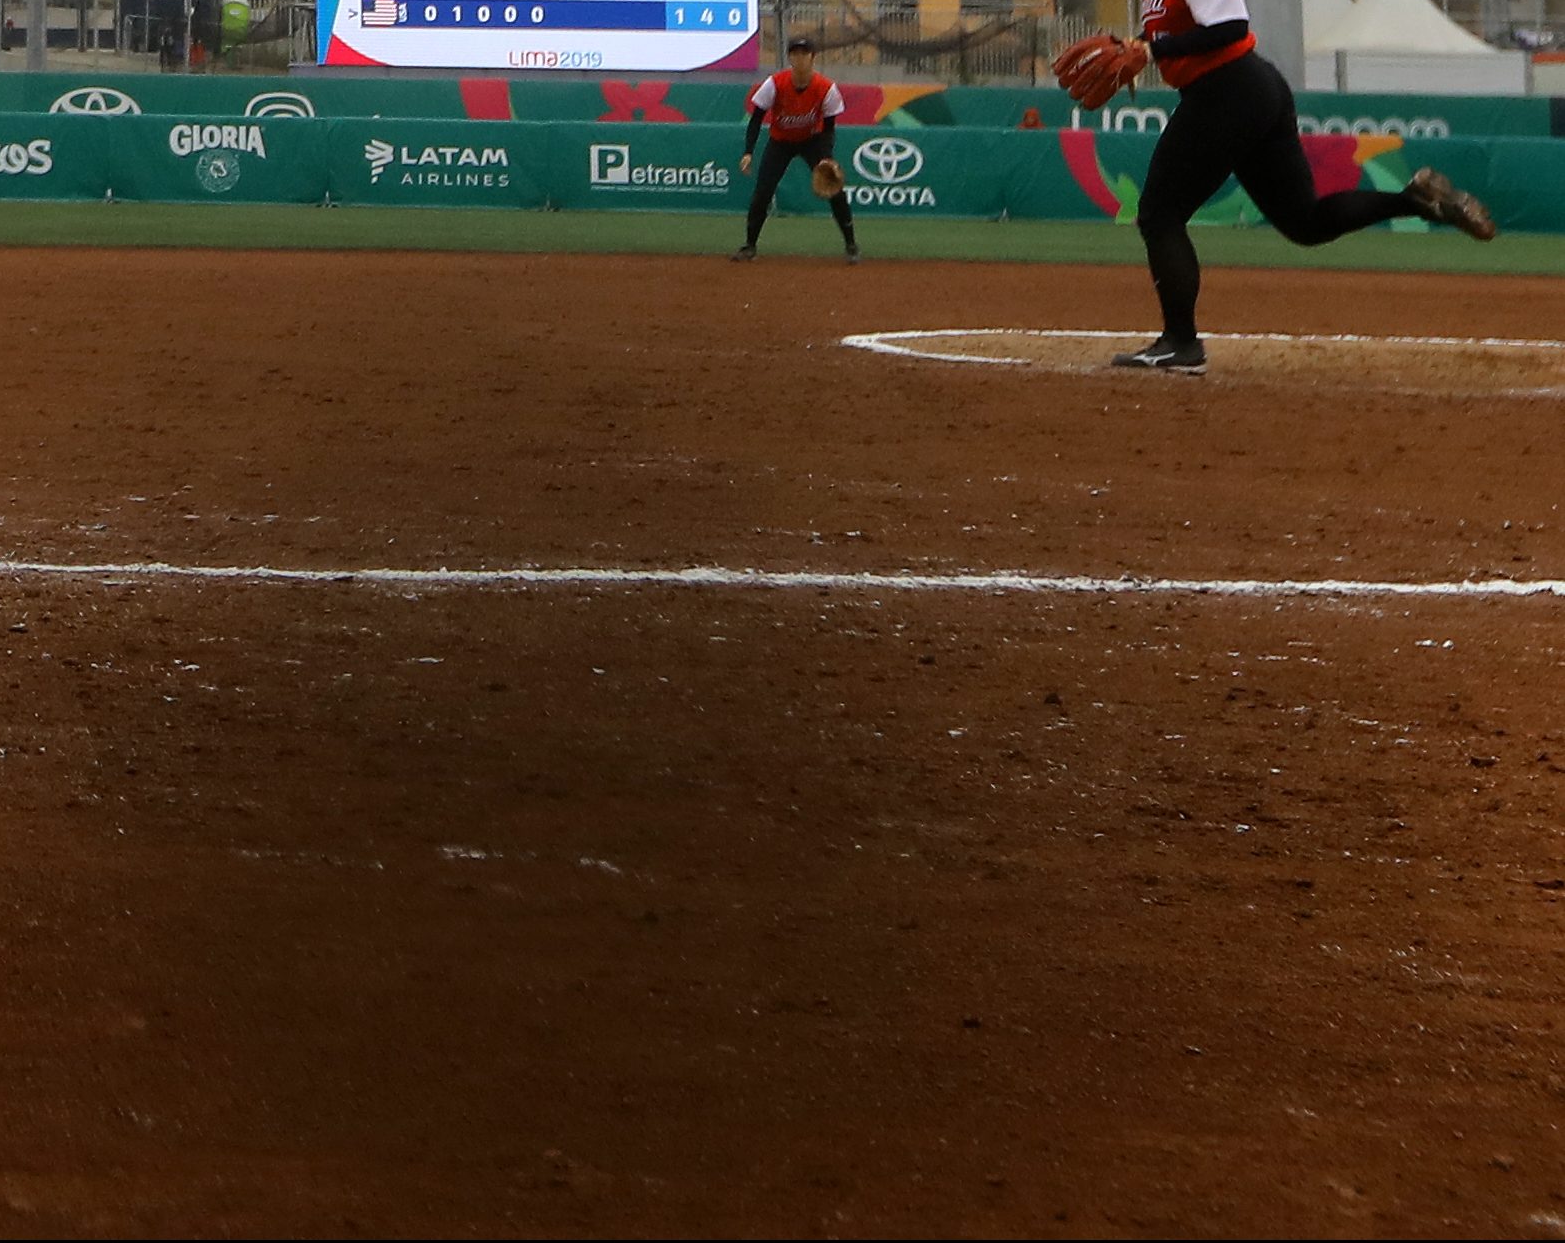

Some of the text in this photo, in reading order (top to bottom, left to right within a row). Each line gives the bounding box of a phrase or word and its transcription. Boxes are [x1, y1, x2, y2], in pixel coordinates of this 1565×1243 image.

[424, 5, 437, 21] 0
[452, 6, 462, 22] 1
[477, 6, 491, 22] 0
[504, 6, 517, 23] 0
[530, 6, 544, 23] 0
[674, 8, 684, 24] 1
[700, 9, 713, 25] 4
[728, 8, 741, 25] 0
[170, 124, 267, 159] GLORIA
[401, 147, 508, 166] LATAM
[590, 144, 729, 185] Petramás
[402, 173, 510, 188] AIRLINES
[843, 186, 935, 207] TOYOTA
